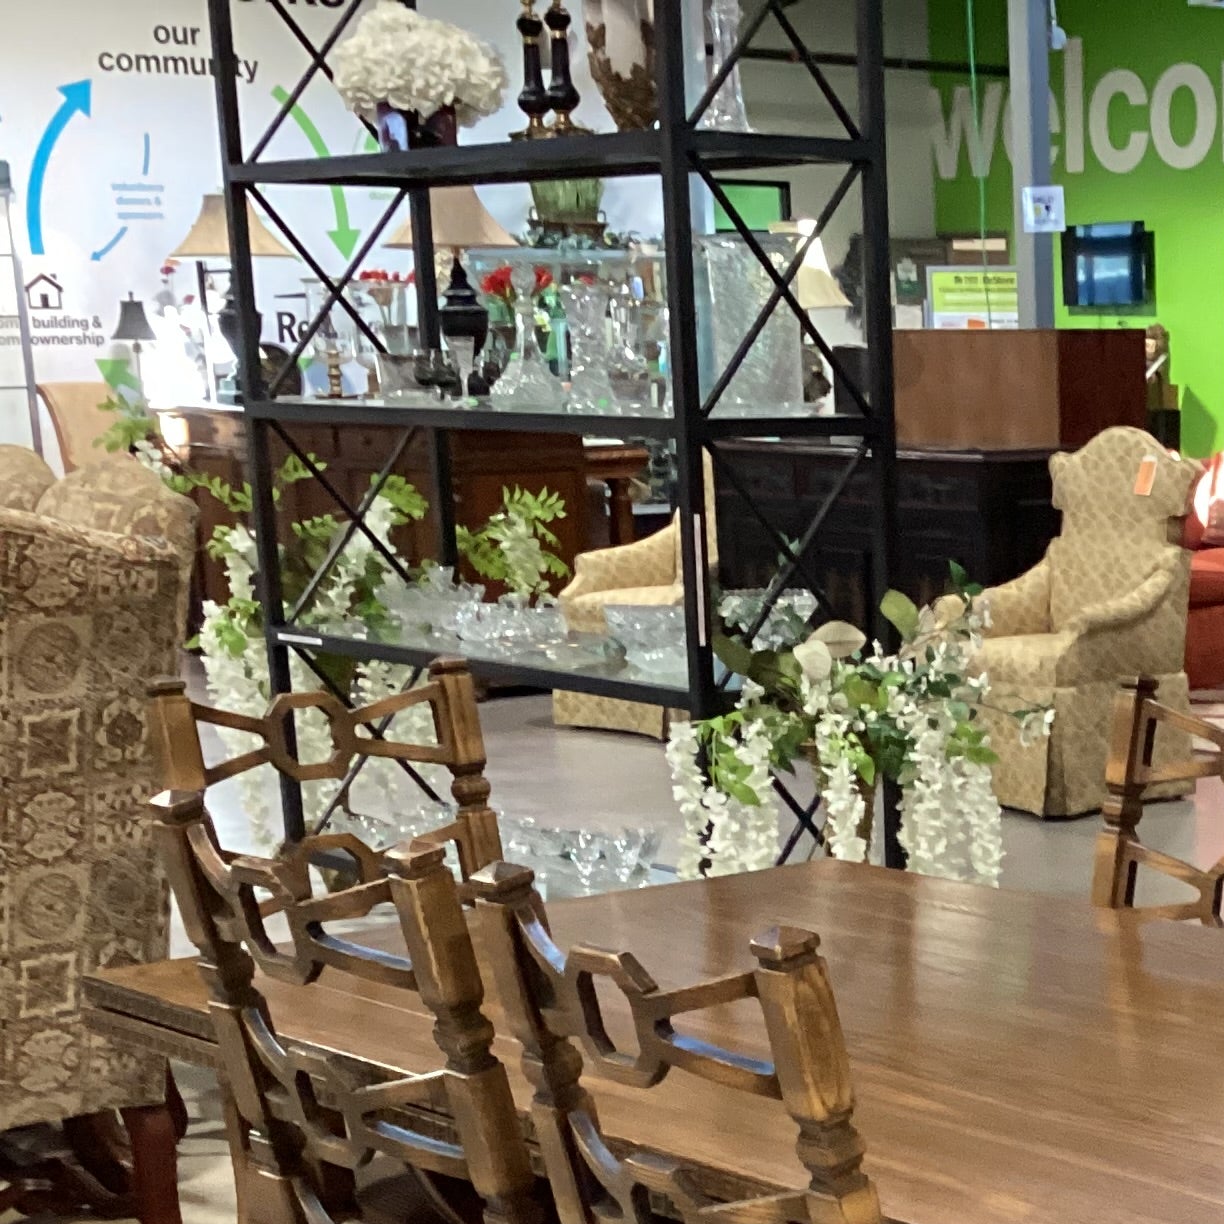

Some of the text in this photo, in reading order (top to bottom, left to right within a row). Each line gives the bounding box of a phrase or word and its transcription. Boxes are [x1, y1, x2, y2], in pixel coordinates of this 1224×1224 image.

[153, 24, 200, 45] our
[97, 51, 258, 84] commuty
[31, 316, 89, 331] building
[92, 316, 102, 329] &
